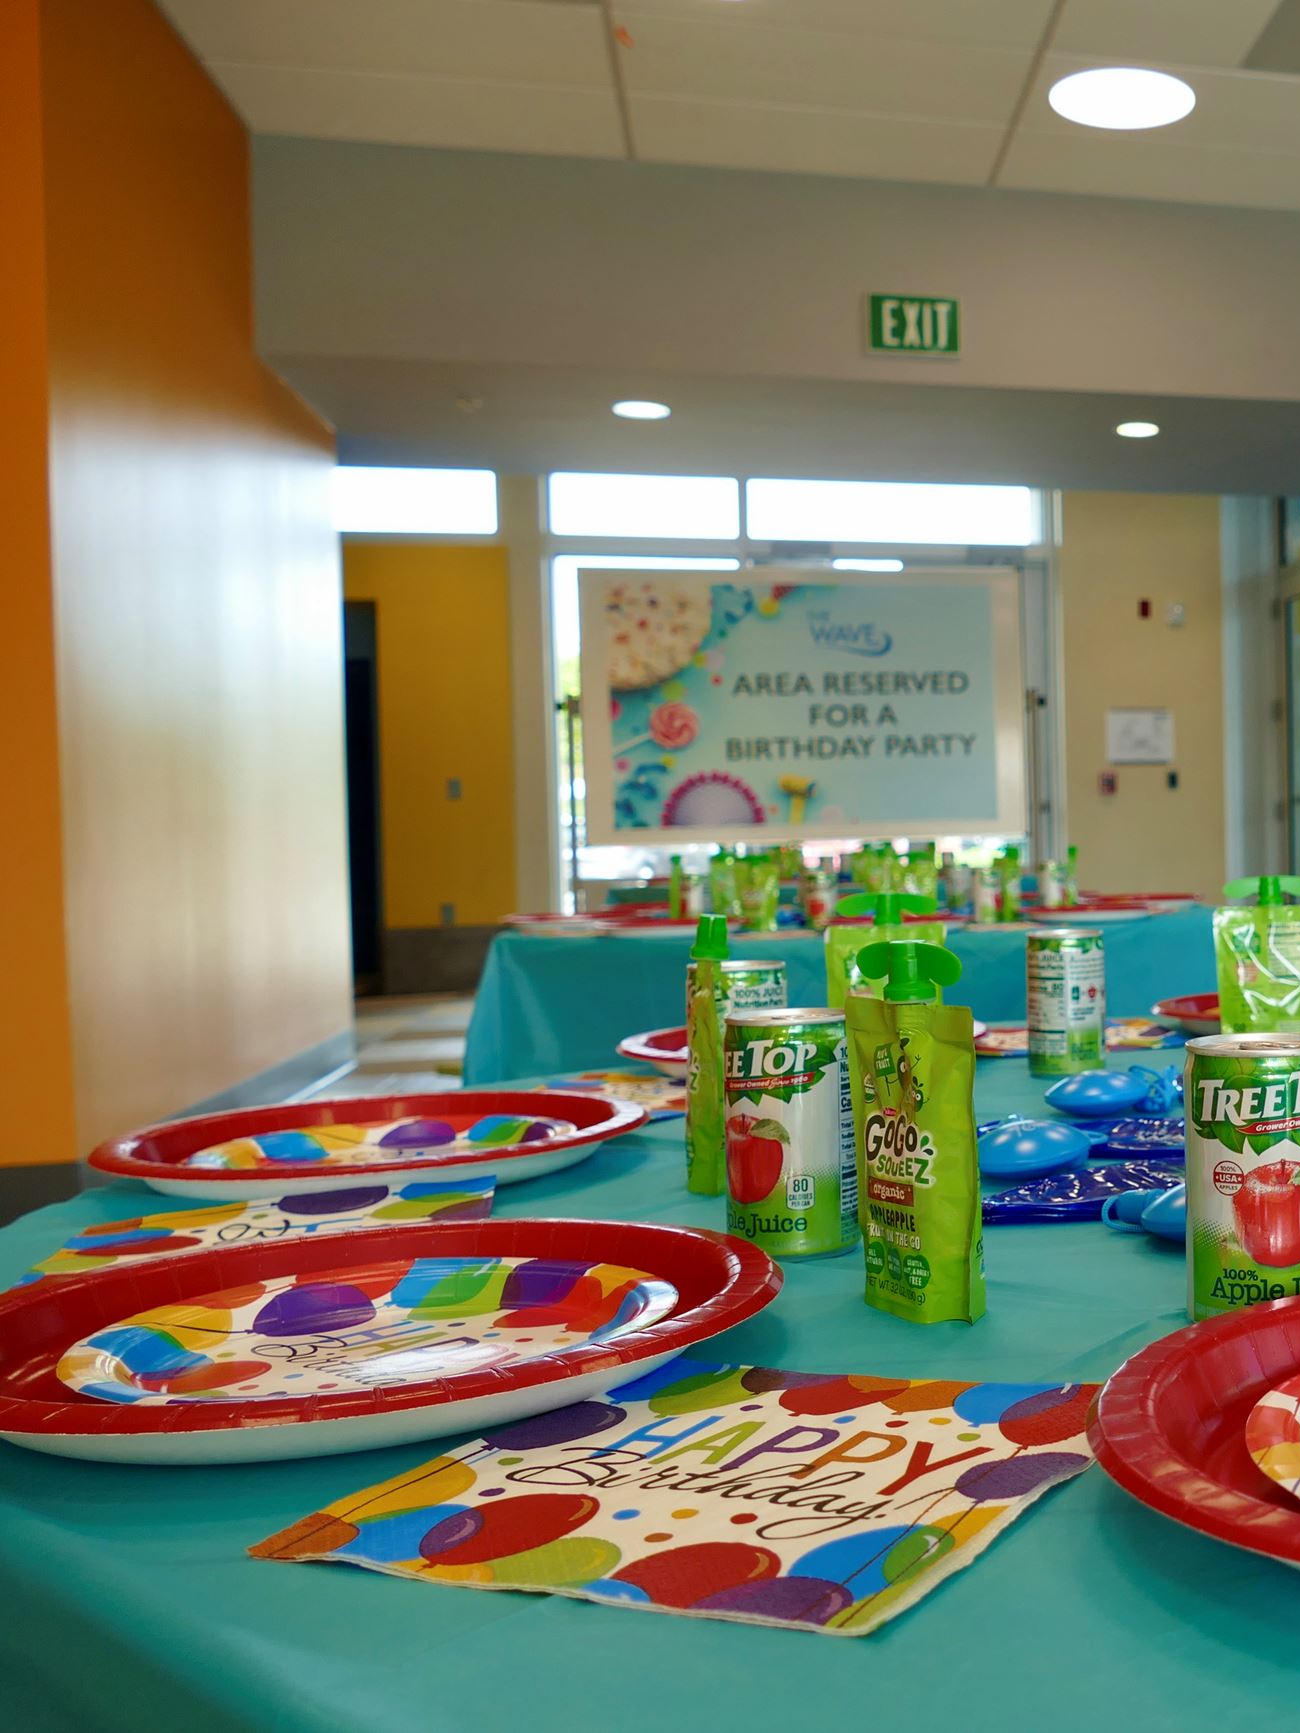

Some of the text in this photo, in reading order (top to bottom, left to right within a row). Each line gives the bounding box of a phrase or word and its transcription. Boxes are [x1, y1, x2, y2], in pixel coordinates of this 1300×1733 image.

[881, 299, 952, 349] EXIT
[809, 623, 880, 647] WAVE
[732, 670, 970, 697] AREA RESERVED
[808, 703, 898, 728] FOR A
[725, 732, 977, 762] BIRTHDAY PARTY
[746, 1079, 770, 1088] Owned
[1255, 1121, 1287, 1132] Grower
[1218, 1173, 1239, 1183] USA
[1219, 1165, 1237, 1173] 100%
[792, 1178, 809, 1192] 80
[873, 1183, 905, 1200] organic
[1218, 1184, 1239, 1192] APPLES
[744, 1213, 808, 1238] Juice
[869, 1203, 916, 1233] APPLEAPPLE
[895, 1232, 909, 1248] THE
[909, 1236, 921, 1251] GO
[1222, 1268, 1259, 1281] 100%
[1210, 1277, 1286, 1306] Apple
[588, 1415, 995, 1496] HAPPY
[504, 1446, 957, 1541] Birthday!
